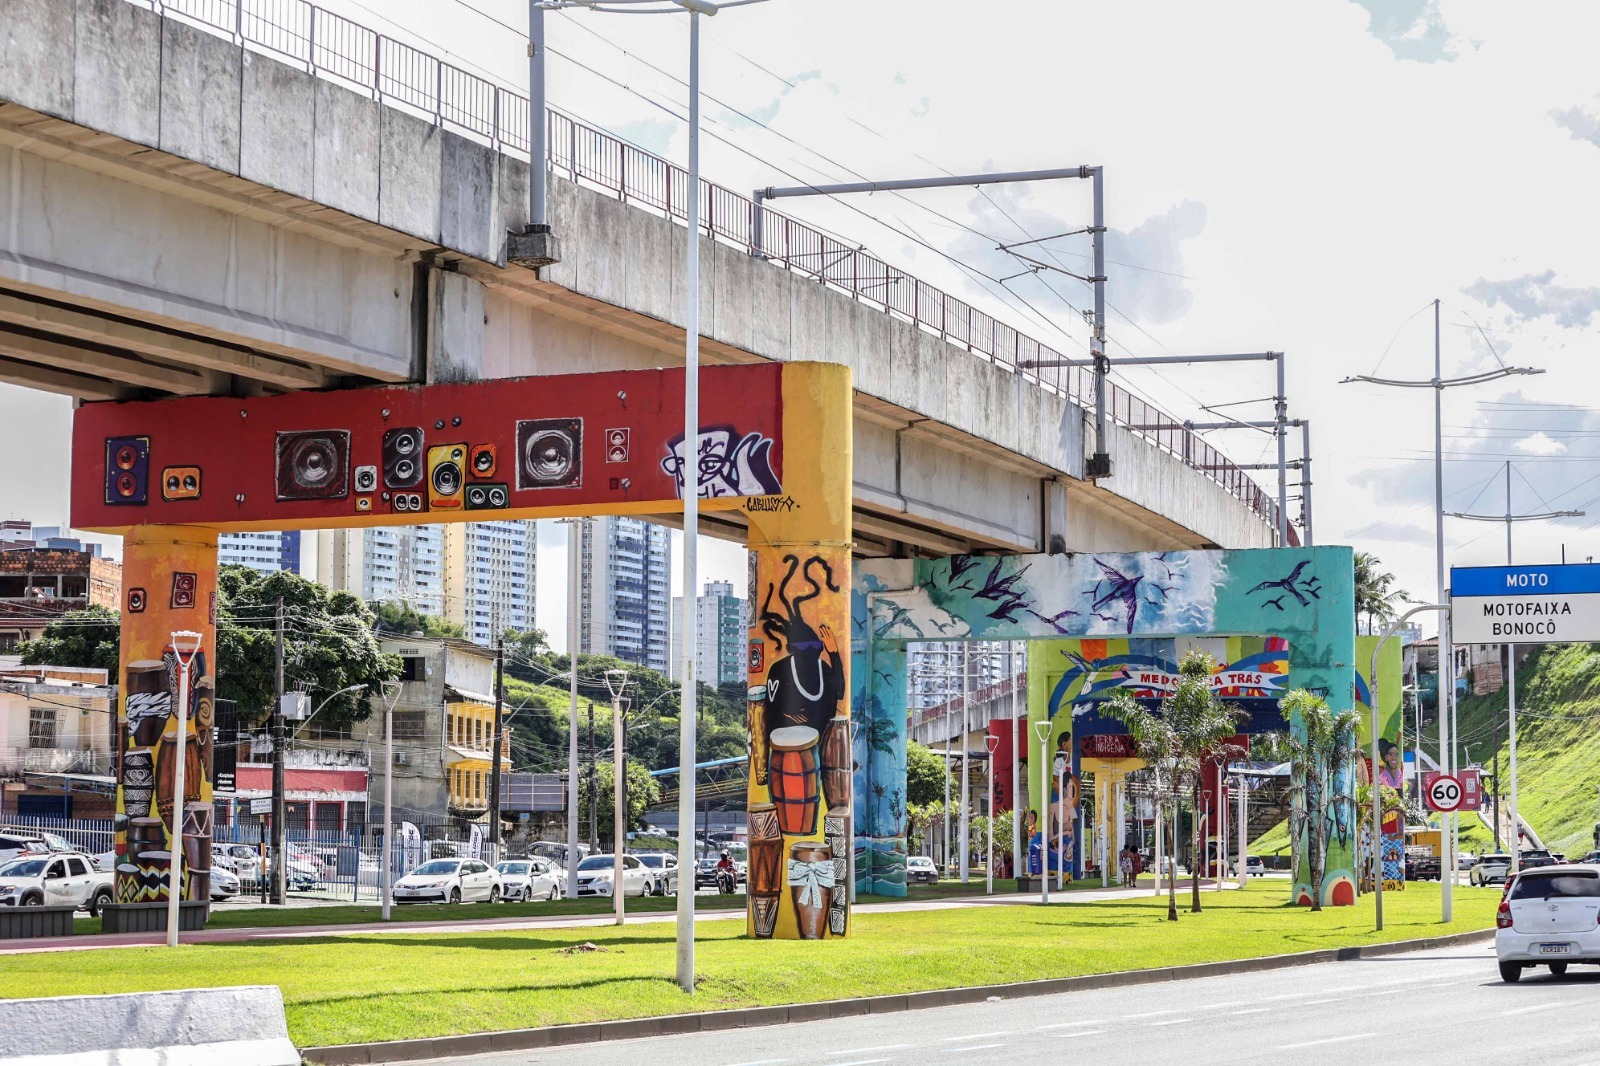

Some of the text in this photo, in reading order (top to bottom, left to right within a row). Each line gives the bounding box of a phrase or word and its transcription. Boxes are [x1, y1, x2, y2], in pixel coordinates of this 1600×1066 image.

[1506, 573, 1548, 587] MOTO
[1483, 602, 1572, 616] MOTOFAIXA
[1492, 619, 1556, 635] BONOCÔ
[1228, 672, 1263, 685] TRÁS
[1094, 735, 1120, 744] TERRA
[1432, 784, 1459, 800] 60
